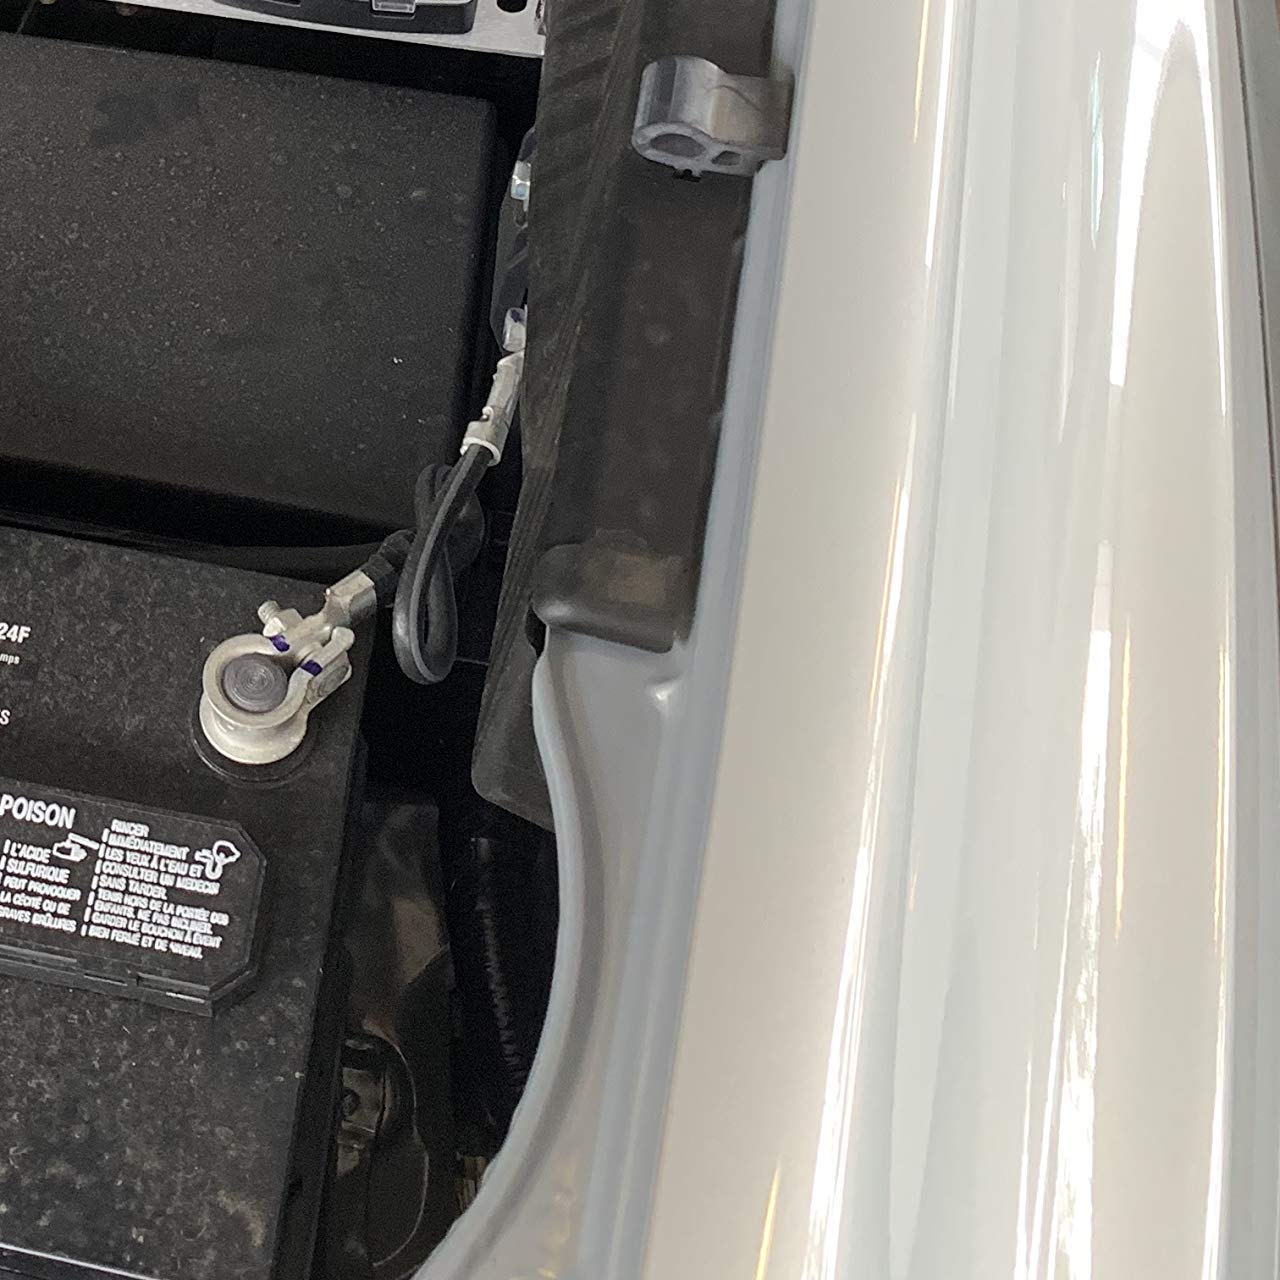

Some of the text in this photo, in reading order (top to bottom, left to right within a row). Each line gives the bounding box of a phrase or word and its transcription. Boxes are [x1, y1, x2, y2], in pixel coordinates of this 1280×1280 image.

[111, 818, 150, 838] RINCER
[10, 842, 51, 864] L'ACIDE
[104, 847, 124, 862] LES
[125, 853, 152, 868] YEUX
[189, 865, 204, 878] ET
[6, 859, 71, 884] SULFURIQUE
[102, 860, 159, 883] CONSULTER
[99, 874, 127, 891] SANS
[0, 890, 12, 903] LA
[42, 899, 58, 912] OU
[163, 902, 175, 915] LA
[128, 918, 141, 931] LE
[141, 936, 155, 948] ET
